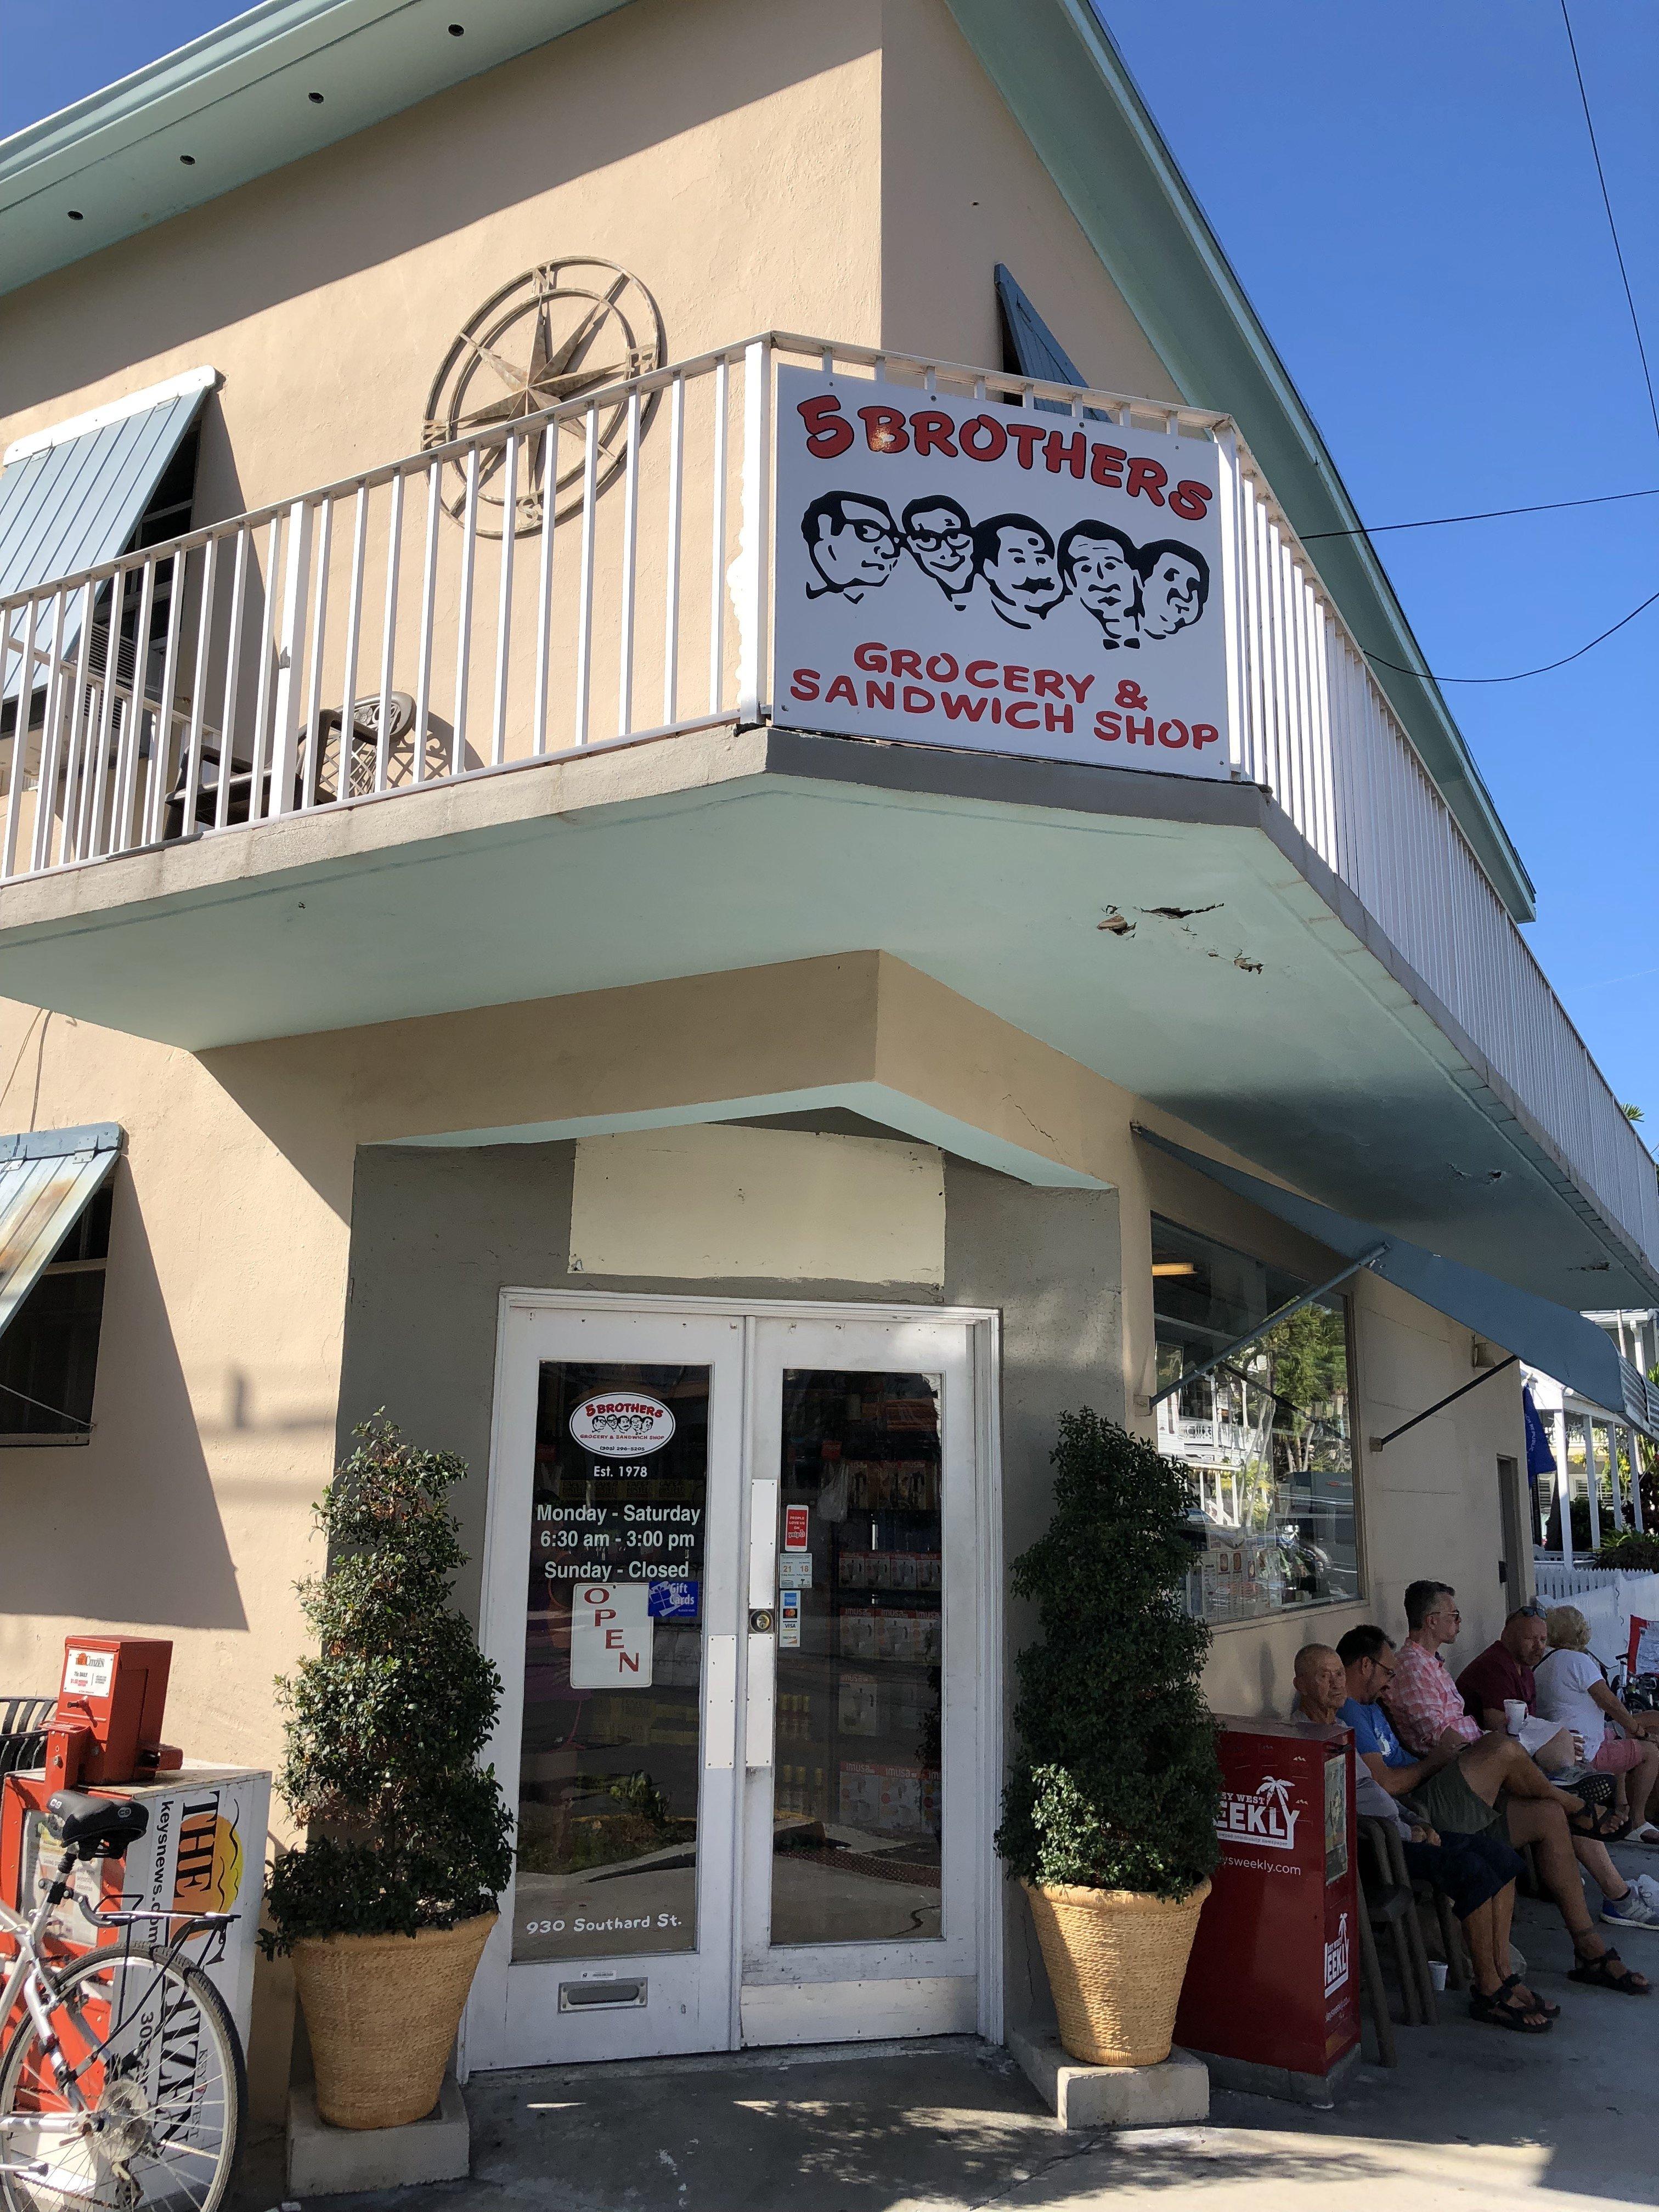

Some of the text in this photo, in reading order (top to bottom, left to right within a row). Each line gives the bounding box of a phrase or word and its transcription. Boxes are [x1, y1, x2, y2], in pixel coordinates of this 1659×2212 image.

[797, 394, 1213, 521] 5 BROTHERS
[854, 642, 1148, 712] GROCERY &
[790, 669, 1218, 751] SANDWICH SHOP
[585, 1403, 664, 1418] 5 BROTHERS
[594, 1465, 648, 1477] Est. 1978
[537, 1504, 607, 1525] Monday
[623, 1505, 701, 1525] Saturday
[540, 1530, 578, 1547] 6:30
[583, 1534, 610, 1547] am
[626, 1531, 663, 1547] 3:00
[668, 1534, 695, 1551] pm
[544, 1561, 612, 1582] Sunday
[629, 1561, 689, 1578] Closed
[670, 1582, 688, 1594] Gift
[669, 1594, 695, 1606] Cards
[584, 1588, 639, 1673] OPEN
[86, 1656, 105, 1667] CITIZEN
[49, 1798, 63, 1809] C9
[1236, 1794, 1265, 1805] WEST
[1212, 1801, 1301, 1837] EEKLY
[173, 1790, 220, 1898] THE
[526, 1913, 682, 1935] 930 Southard St.
[189, 2048, 208, 2139] KEY WEST
